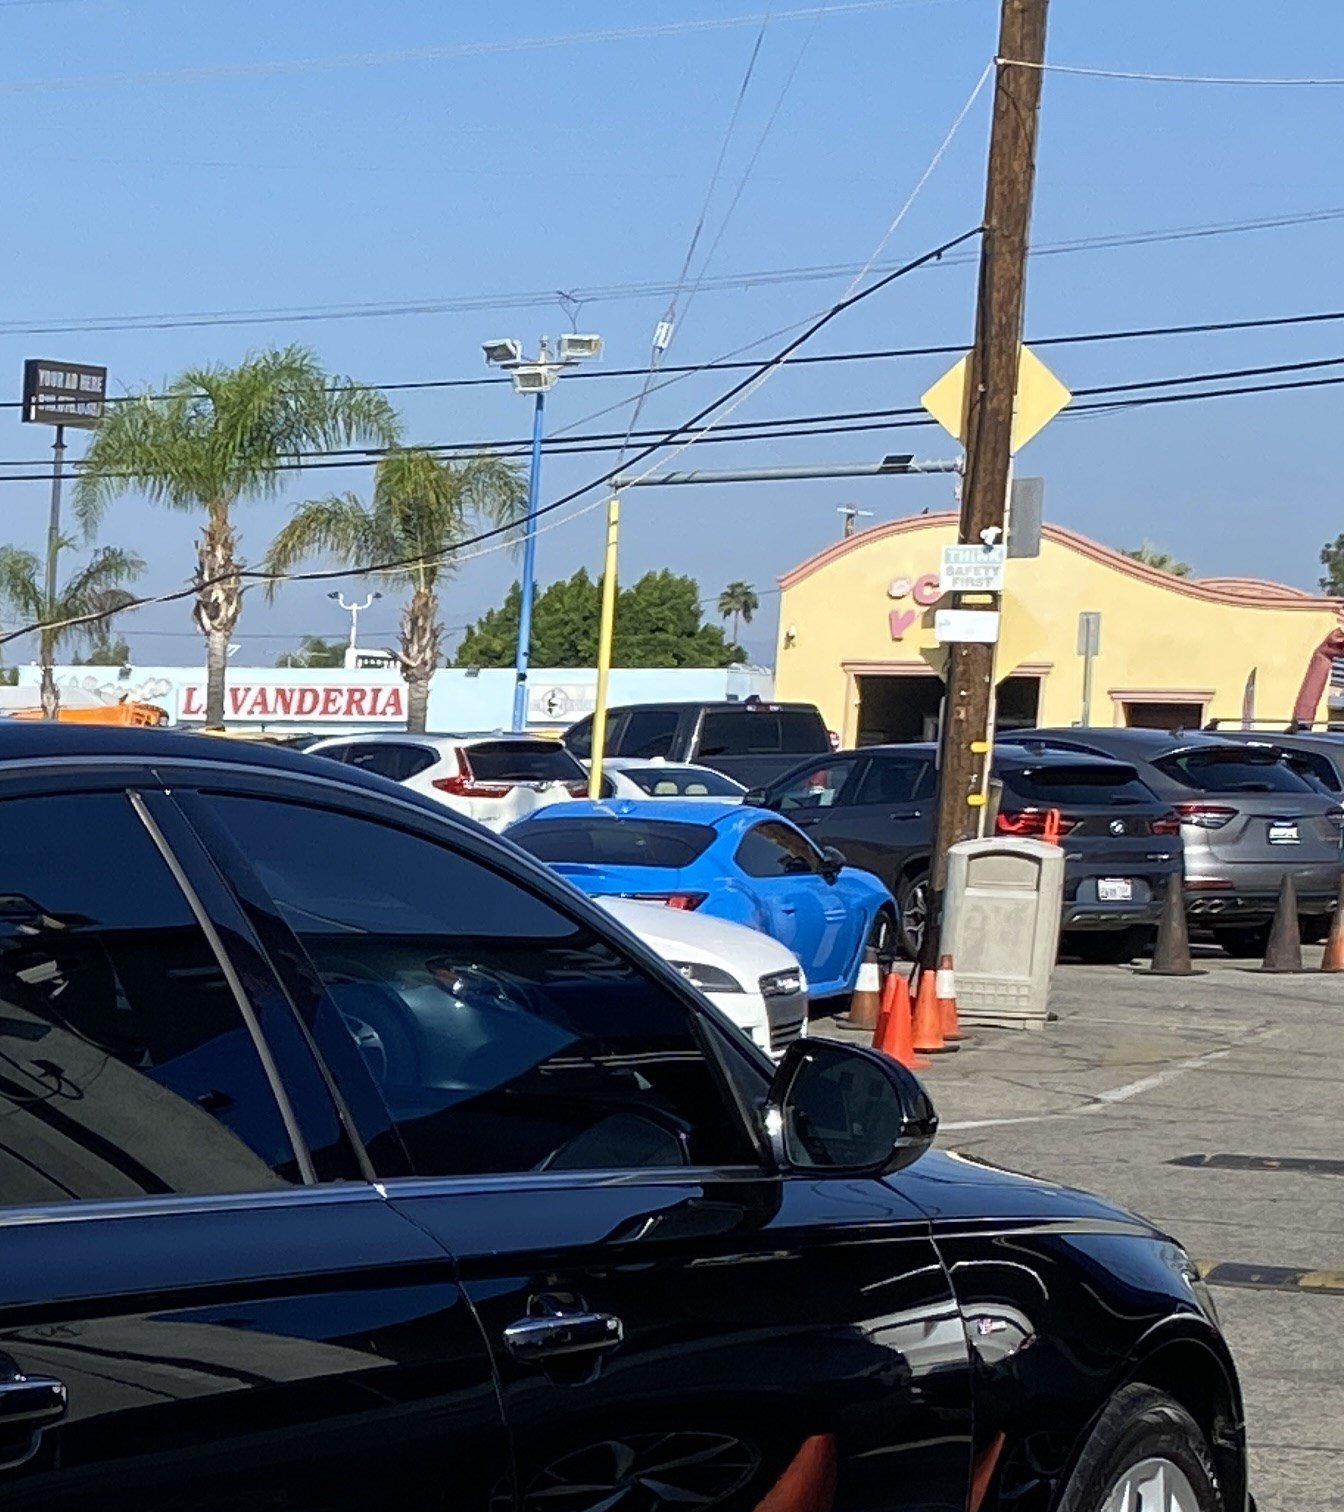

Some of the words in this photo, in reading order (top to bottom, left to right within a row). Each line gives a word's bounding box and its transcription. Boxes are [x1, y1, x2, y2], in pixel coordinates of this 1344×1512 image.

[38, 369, 64, 388] YOUR
[79, 374, 103, 392] HERE
[947, 548, 1002, 563] THINK
[946, 566, 1000, 576] SAFETY
[952, 577, 993, 587] FIRST
[182, 687, 403, 716] LVANDERIA
